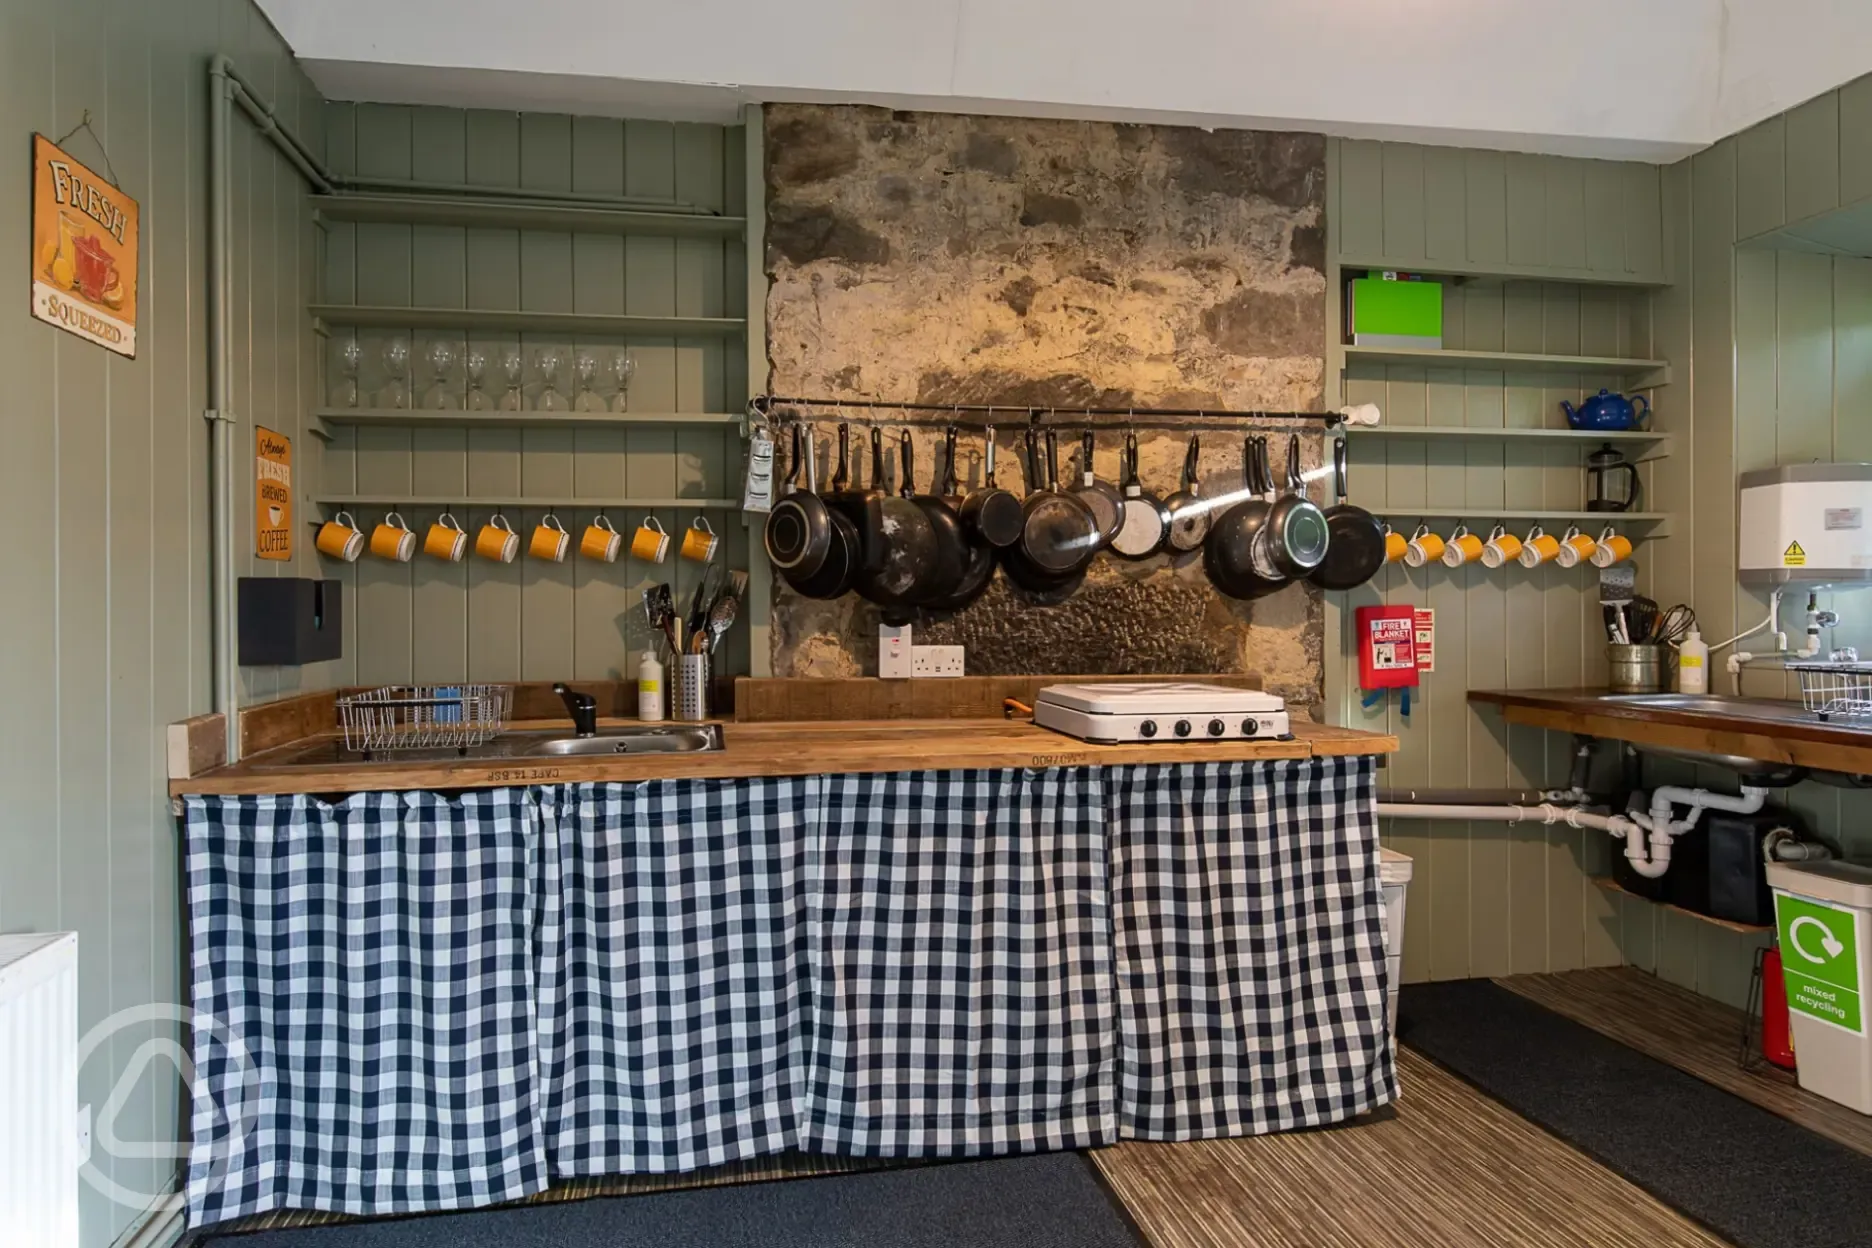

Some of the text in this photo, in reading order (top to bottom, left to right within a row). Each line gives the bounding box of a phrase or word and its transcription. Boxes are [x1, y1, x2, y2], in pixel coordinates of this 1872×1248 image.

[49, 160, 128, 245] FRESH
[48, 294, 122, 344] SQUEEZED
[260, 437, 286, 458] Always
[256, 456, 290, 488] FRESH
[262, 484, 288, 503] BREWED
[260, 529, 288, 552] COFFEE
[1374, 630, 1408, 638] BLANKET
[1803, 985, 1836, 1002] mixed
[1796, 994, 1846, 1019] recycling
